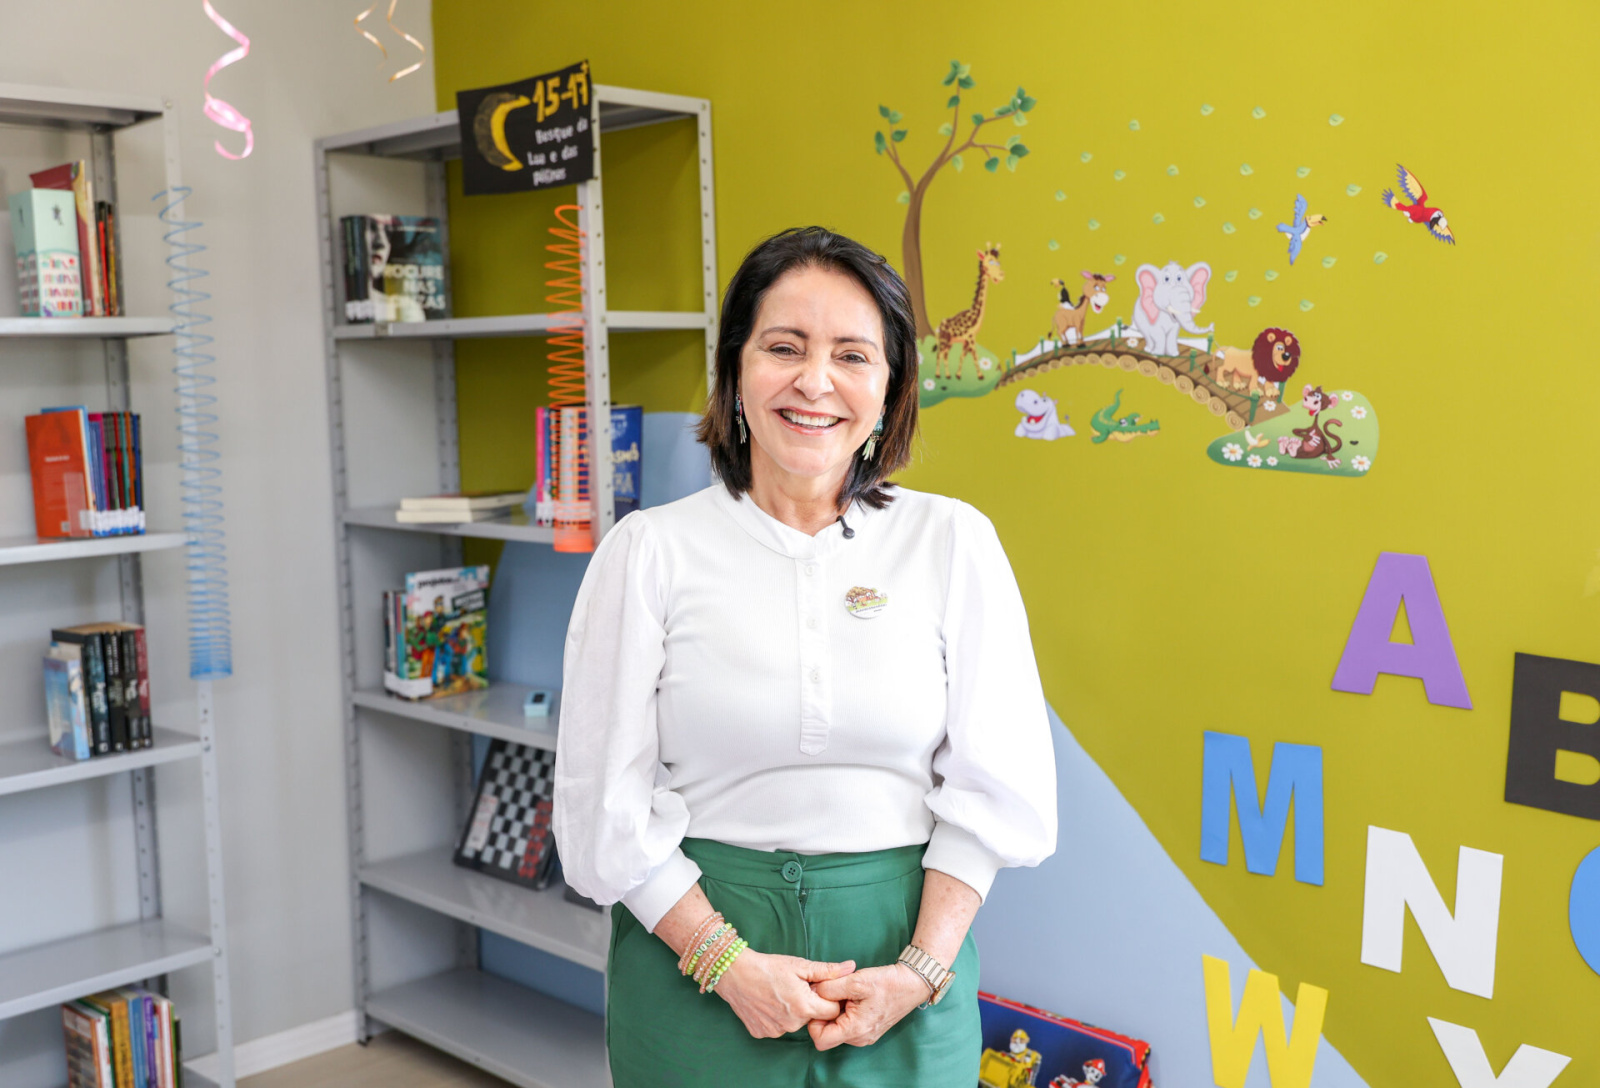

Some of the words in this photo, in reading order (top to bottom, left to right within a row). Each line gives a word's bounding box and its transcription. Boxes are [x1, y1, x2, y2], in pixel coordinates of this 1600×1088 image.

[1331, 551, 1474, 710] A
[1504, 651, 1600, 822] B
[1200, 730, 1324, 887] M
[1360, 824, 1504, 1000] N
[1202, 953, 1329, 1088] W
